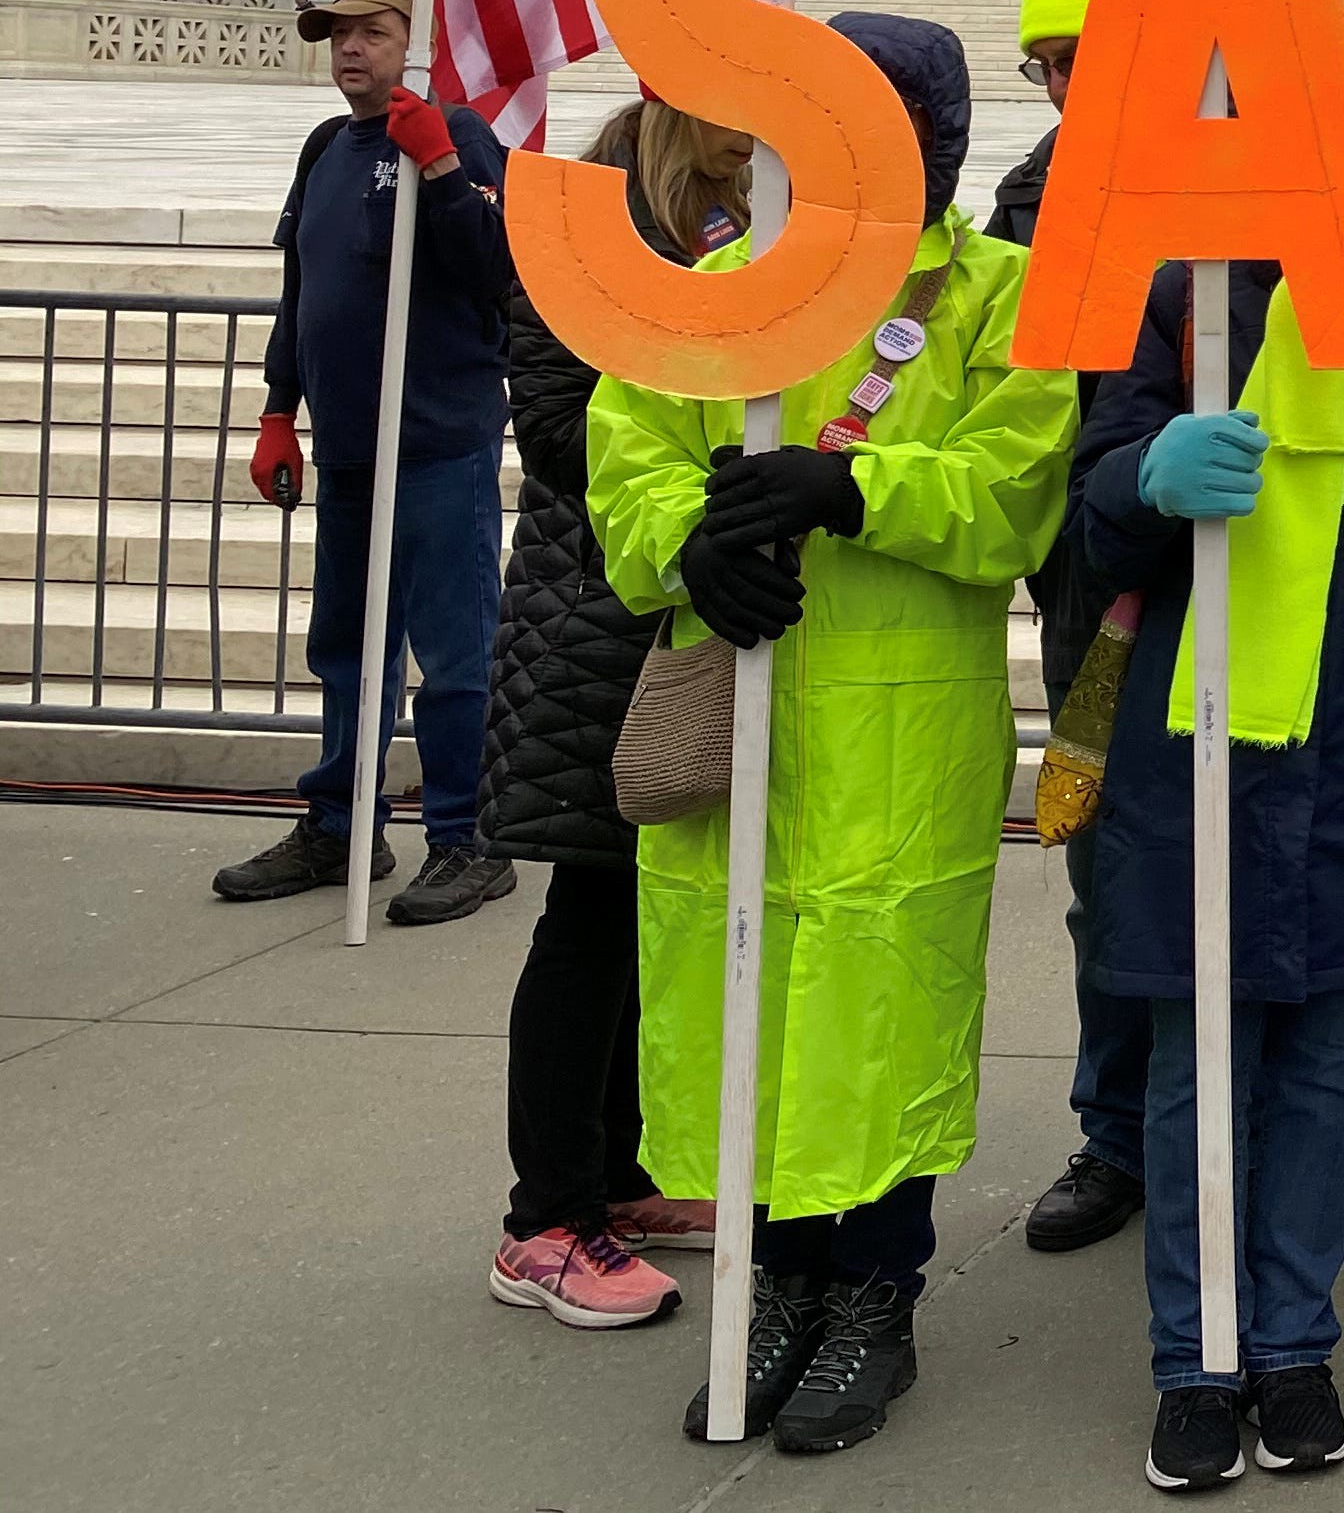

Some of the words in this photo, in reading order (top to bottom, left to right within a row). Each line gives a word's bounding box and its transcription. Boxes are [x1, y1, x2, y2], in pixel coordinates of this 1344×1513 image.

[879, 332, 909, 349] ACTION
[882, 327, 916, 346] DEMAND
[827, 423, 852, 436] MOMS
